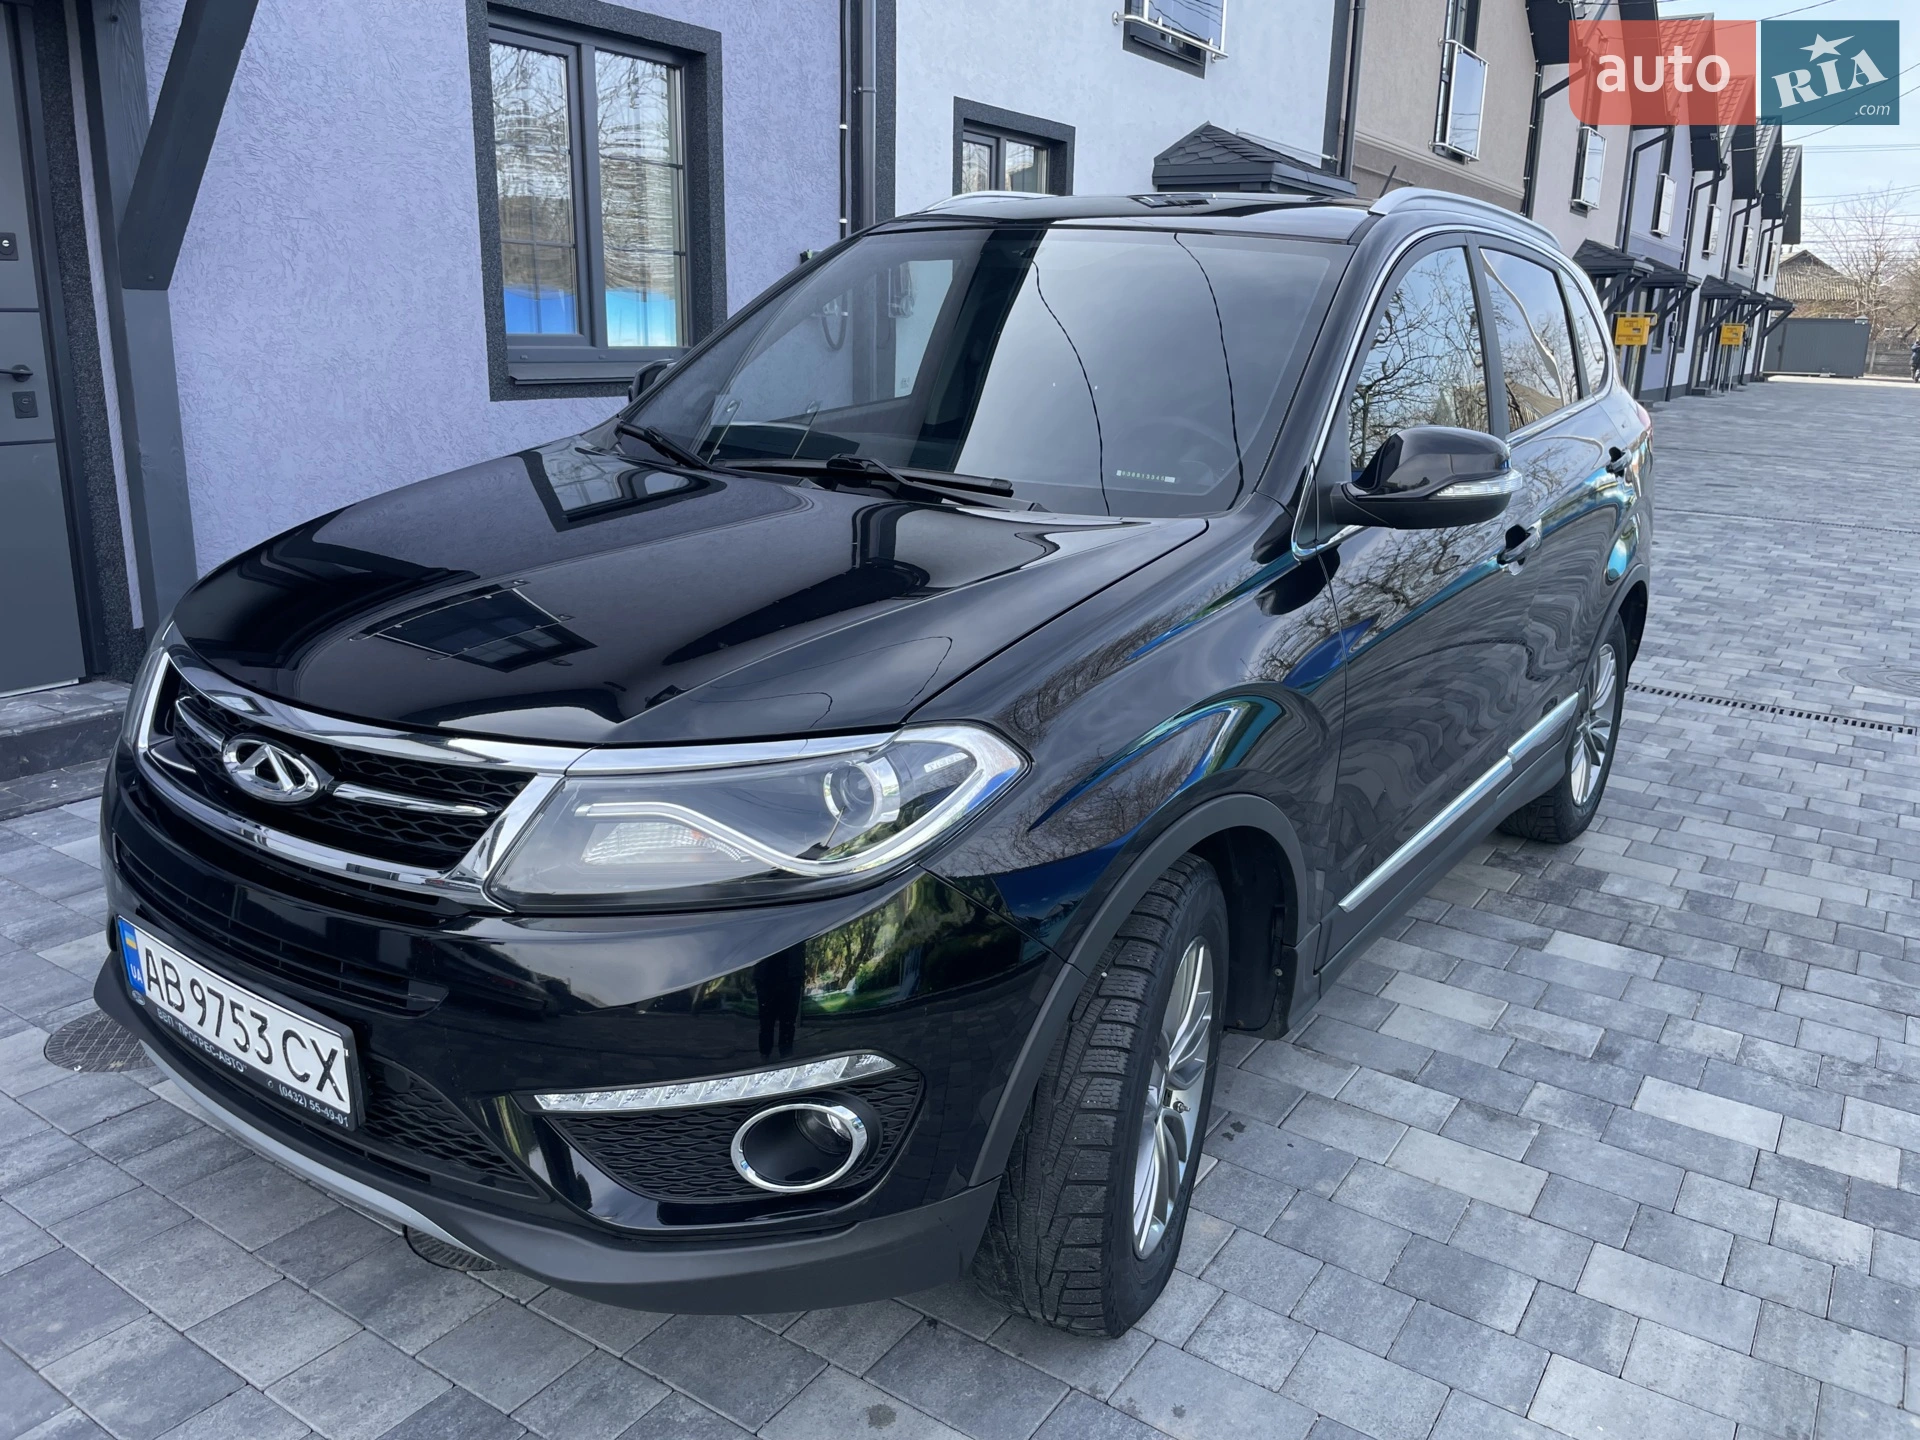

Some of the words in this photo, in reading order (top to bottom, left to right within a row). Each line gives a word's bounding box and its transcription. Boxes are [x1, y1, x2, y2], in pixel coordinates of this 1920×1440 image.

[130, 963, 143, 984] UA
[144, 946, 186, 1013] AB
[189, 978, 274, 1064] 9753
[282, 1029, 346, 1103] CX
[279, 1083, 307, 1108] (0432)
[309, 1099, 349, 1127] 55-49-01
